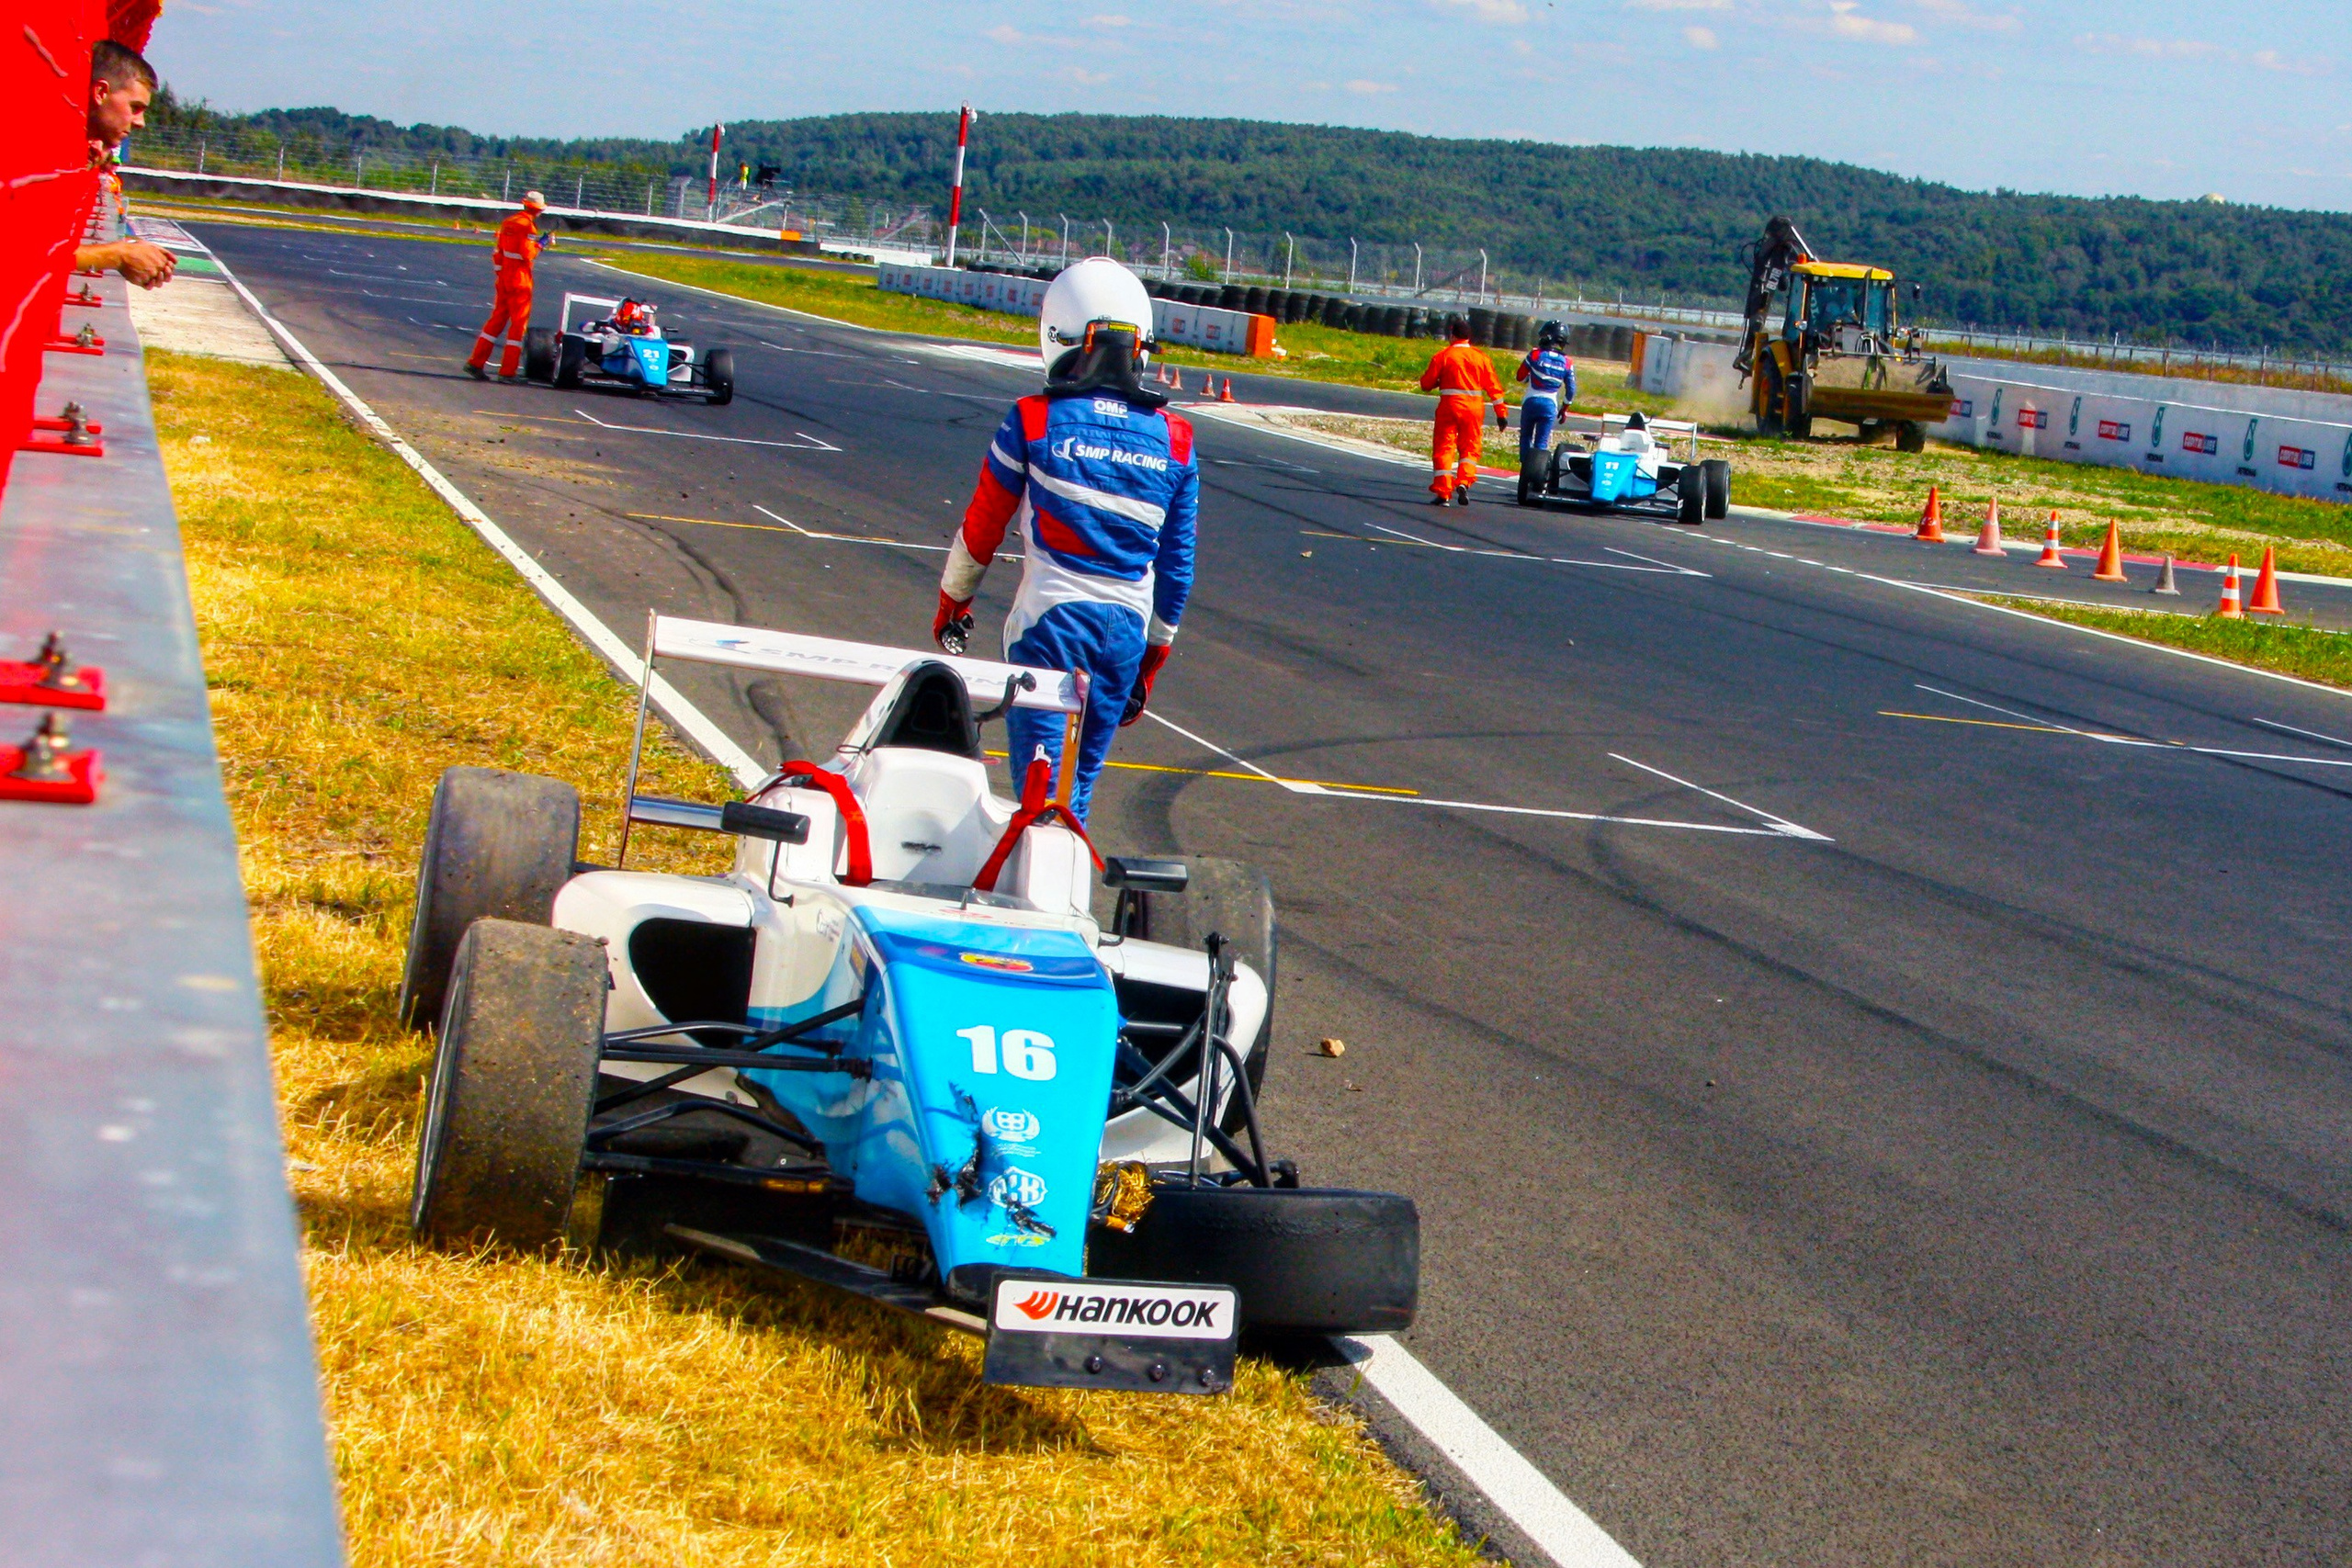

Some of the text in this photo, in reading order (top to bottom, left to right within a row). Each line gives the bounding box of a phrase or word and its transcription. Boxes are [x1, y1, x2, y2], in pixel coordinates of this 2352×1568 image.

[643, 348, 660, 359] 21
[1093, 400, 1128, 415] OMP
[1075, 445, 1168, 472] SMP RACING
[1605, 461, 1620, 470] 11
[956, 1024, 1057, 1081] 16
